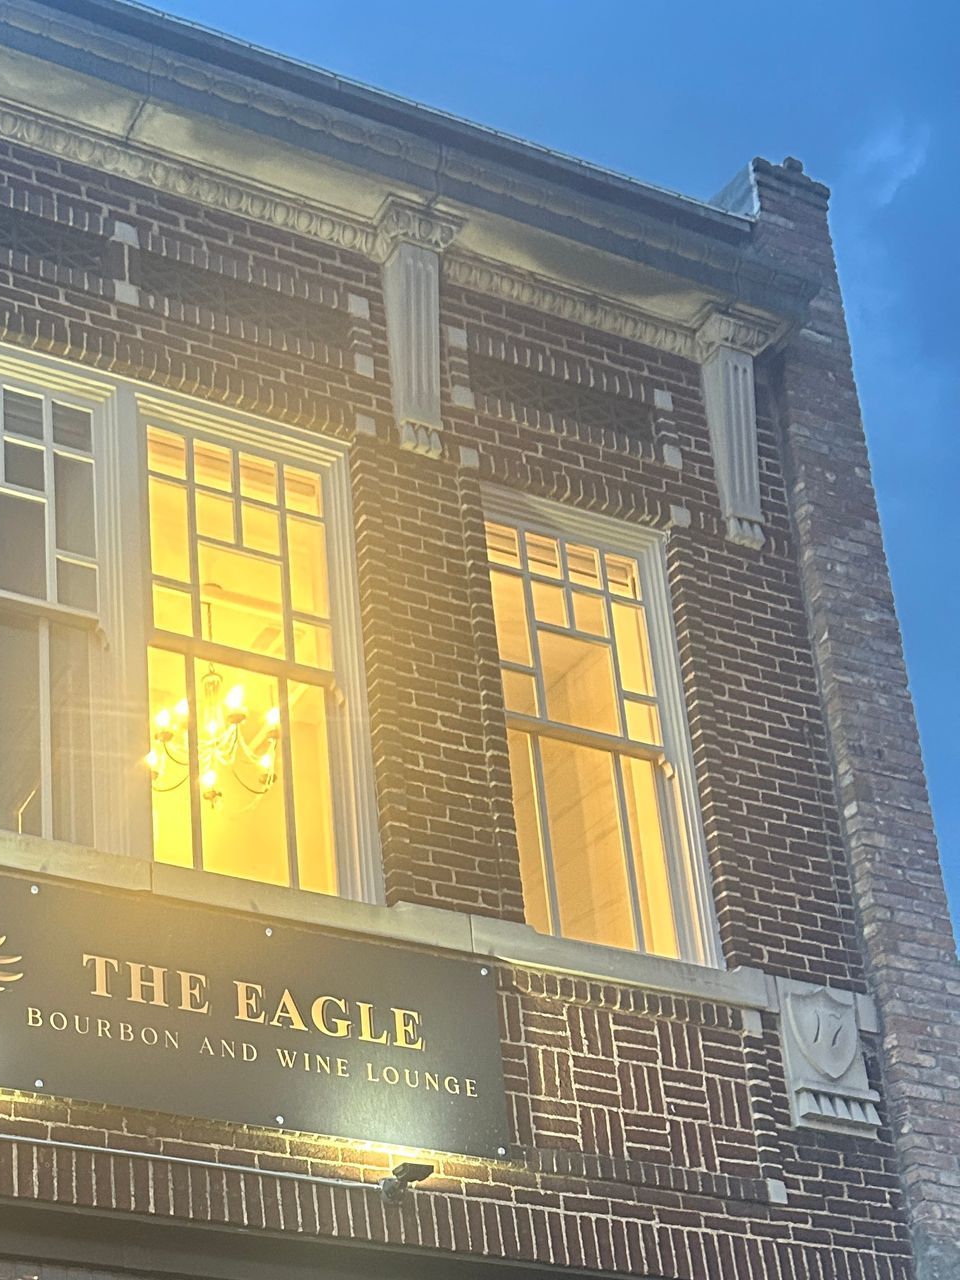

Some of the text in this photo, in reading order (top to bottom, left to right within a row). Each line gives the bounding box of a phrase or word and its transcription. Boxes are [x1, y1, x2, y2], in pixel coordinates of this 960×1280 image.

[82, 953, 424, 1051] THE EAGLE
[27, 1007, 478, 1098] BOURBON AND WINE LOUNGE
